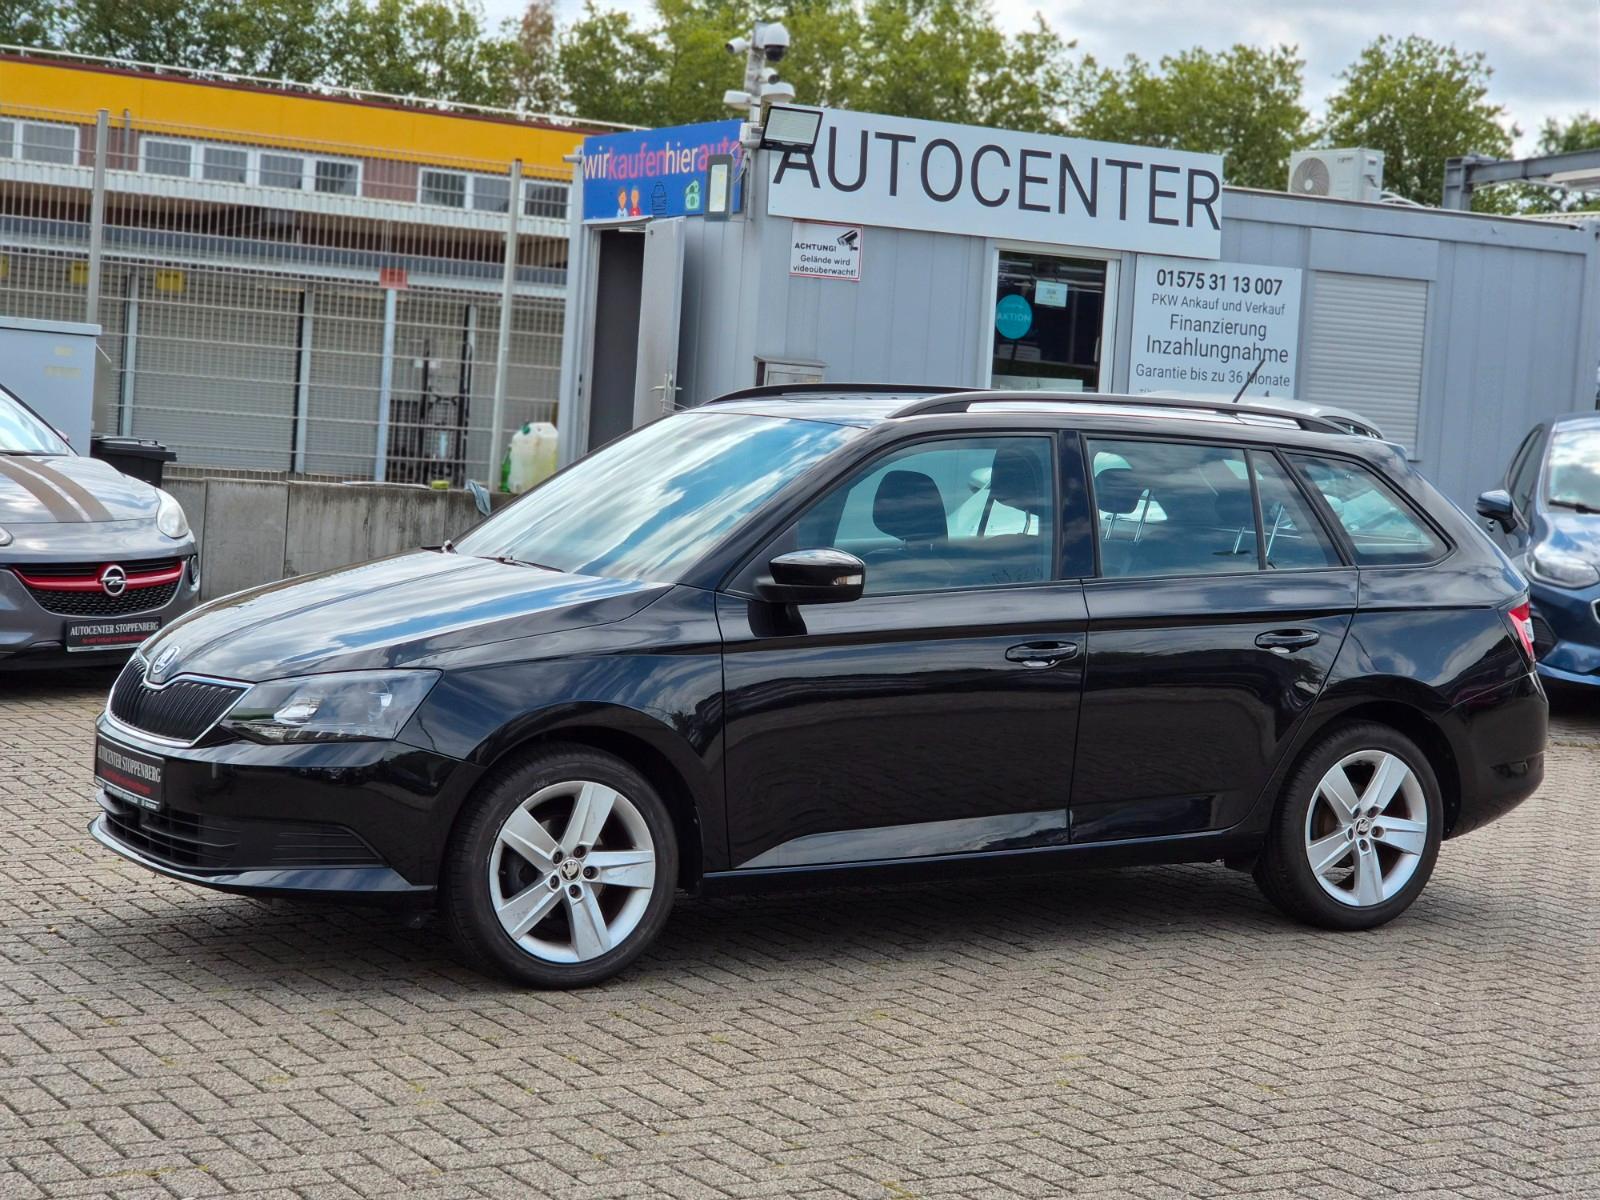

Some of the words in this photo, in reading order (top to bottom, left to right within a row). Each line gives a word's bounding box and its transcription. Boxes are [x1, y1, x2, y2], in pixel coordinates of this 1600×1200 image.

[773, 126, 1221, 230] AUTOCENTER
[794, 242, 837, 252] ACHTUNG!
[793, 264, 856, 276] videoüberwacht!
[800, 254, 832, 264] Gelände
[834, 257, 851, 266] wird
[1156, 269, 1205, 290] 01575
[1209, 274, 1226, 291] 31
[1233, 276, 1250, 293] 13
[1254, 278, 1283, 296] 007
[1152, 293, 1178, 306] PKW
[1181, 296, 1219, 310] Ankauf
[1222, 300, 1242, 312] und
[1245, 301, 1286, 315] Verkauf
[1170, 313, 1267, 341] Finanzierung
[1146, 335, 1289, 364] Inzahlungnahme
[1136, 364, 1187, 380] Garantie
[1190, 367, 1208, 381] bis
[1210, 371, 1225, 383] zu
[1229, 370, 1243, 384] 36
[1247, 371, 1290, 387] Monate
[70, 624, 114, 636] AUTOCENTER
[115, 621, 159, 633] STOPPENBERG
[122, 756, 161, 783] STOPPENBERG
